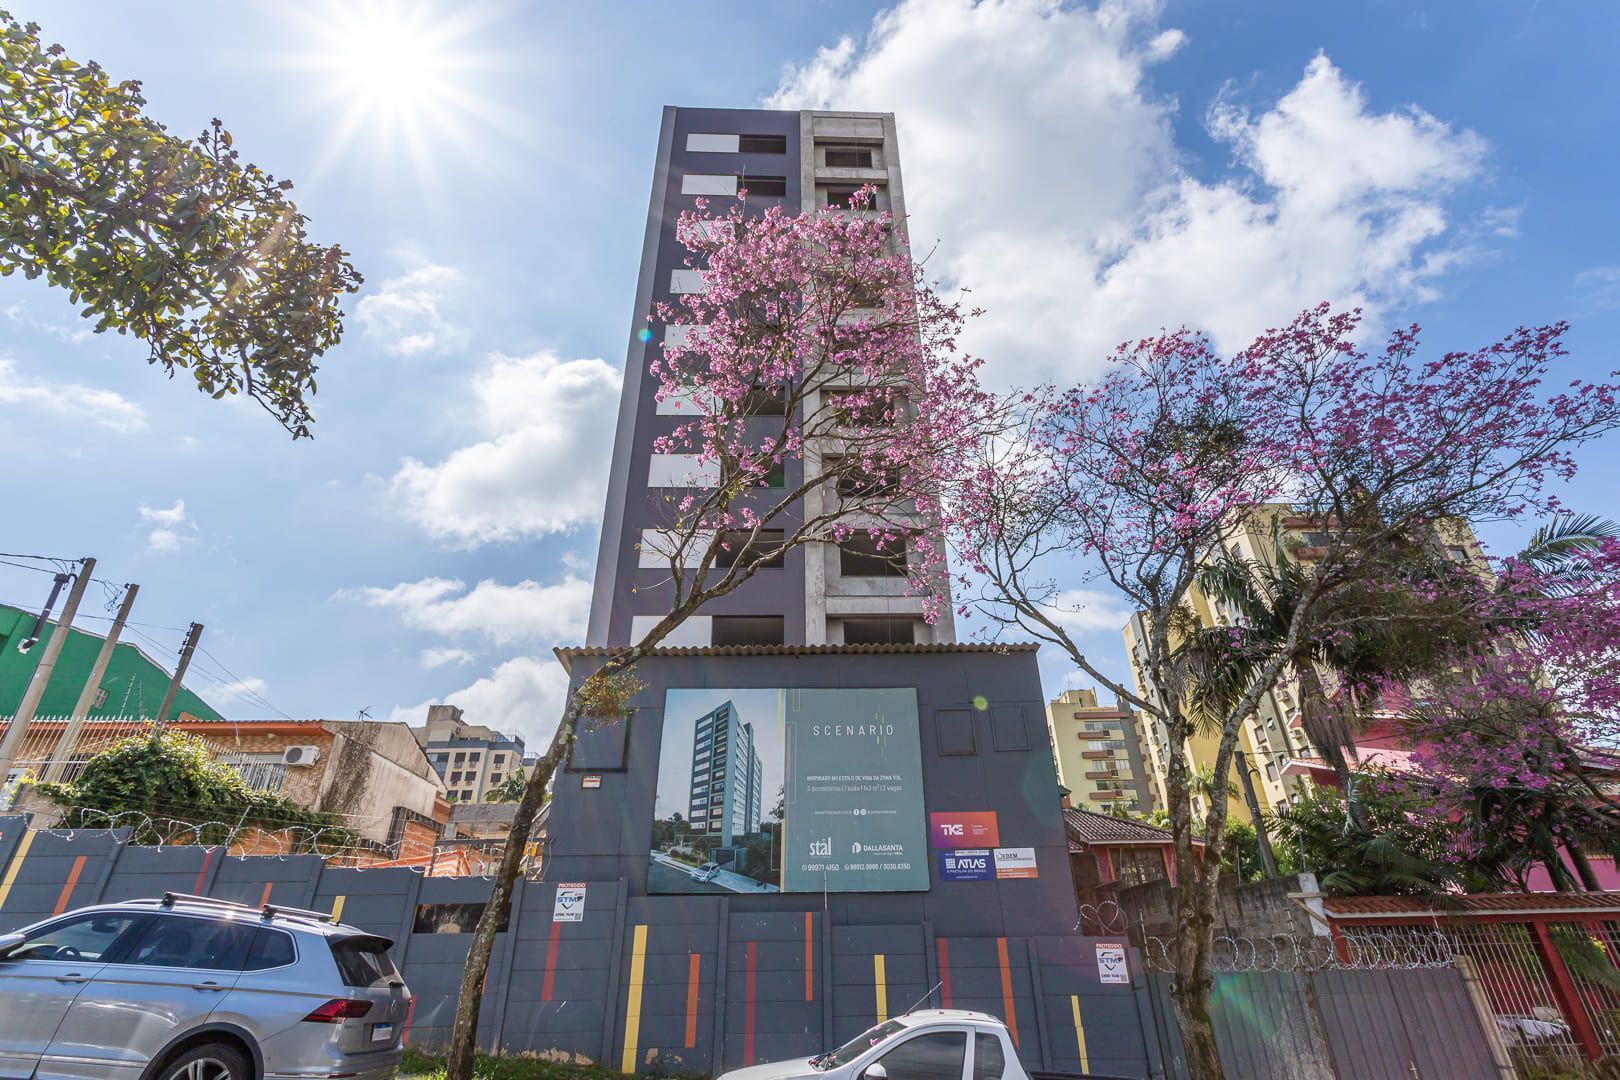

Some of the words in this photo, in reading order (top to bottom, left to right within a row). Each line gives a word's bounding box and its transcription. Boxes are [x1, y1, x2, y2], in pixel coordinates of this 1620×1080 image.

[813, 724, 893, 736] SCENARIO
[940, 824, 964, 836] TKE
[863, 844, 903, 852] DALLASANTA
[957, 858, 986, 869] ATLAS
